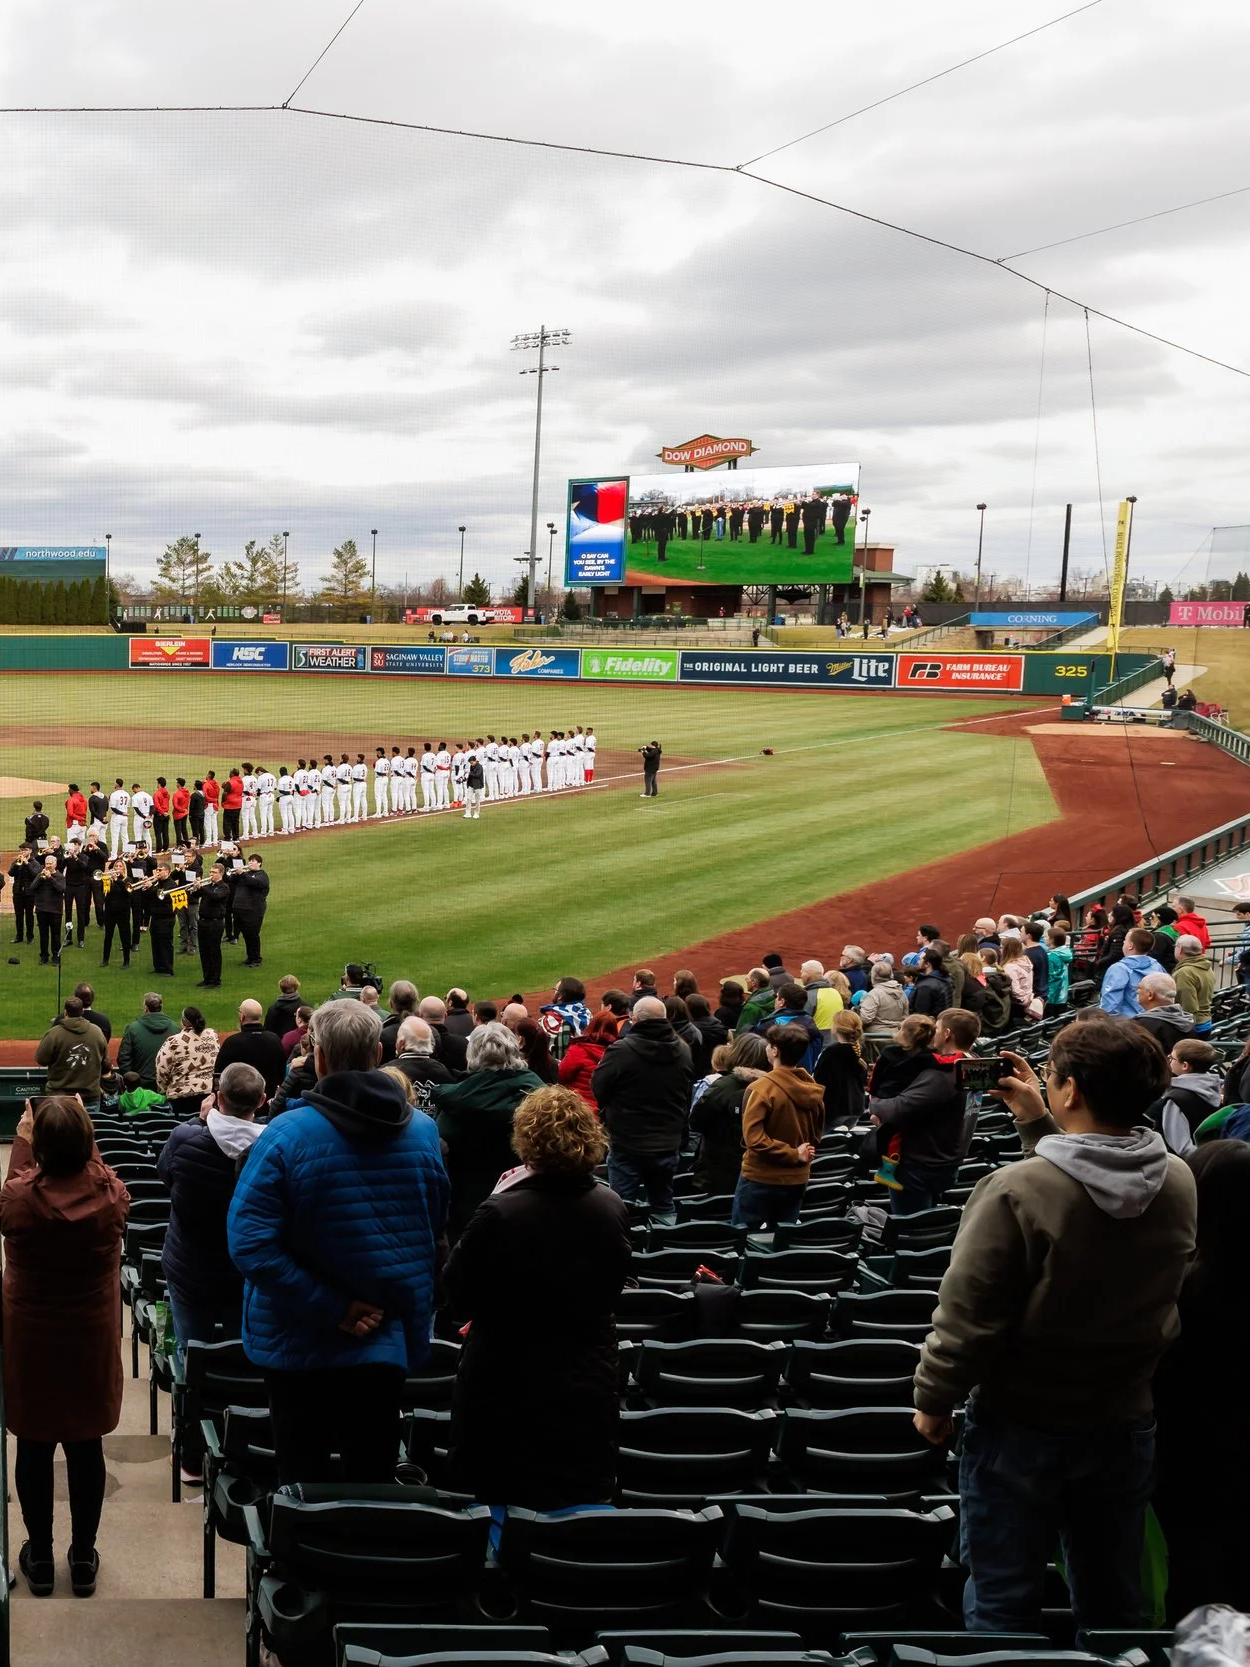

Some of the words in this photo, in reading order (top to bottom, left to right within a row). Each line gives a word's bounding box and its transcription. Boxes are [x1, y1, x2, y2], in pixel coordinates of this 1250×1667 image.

[664, 449, 691, 461] DOW
[693, 440, 748, 458] DIAMOND
[1007, 615, 1057, 623] CORNING
[232, 647, 266, 661] HSC
[331, 648, 356, 657] ALERT
[309, 657, 356, 667] WEATHER
[605, 657, 672, 675] Fidelity
[695, 662, 748, 672] ORIGINAL
[751, 663, 785, 673] LIGHT
[788, 664, 819, 674] BEER
[826, 662, 854, 675] Miller
[851, 658, 889, 682] Lite
[1054, 666, 1087, 677] 325
[120, 796, 128, 805] 37
